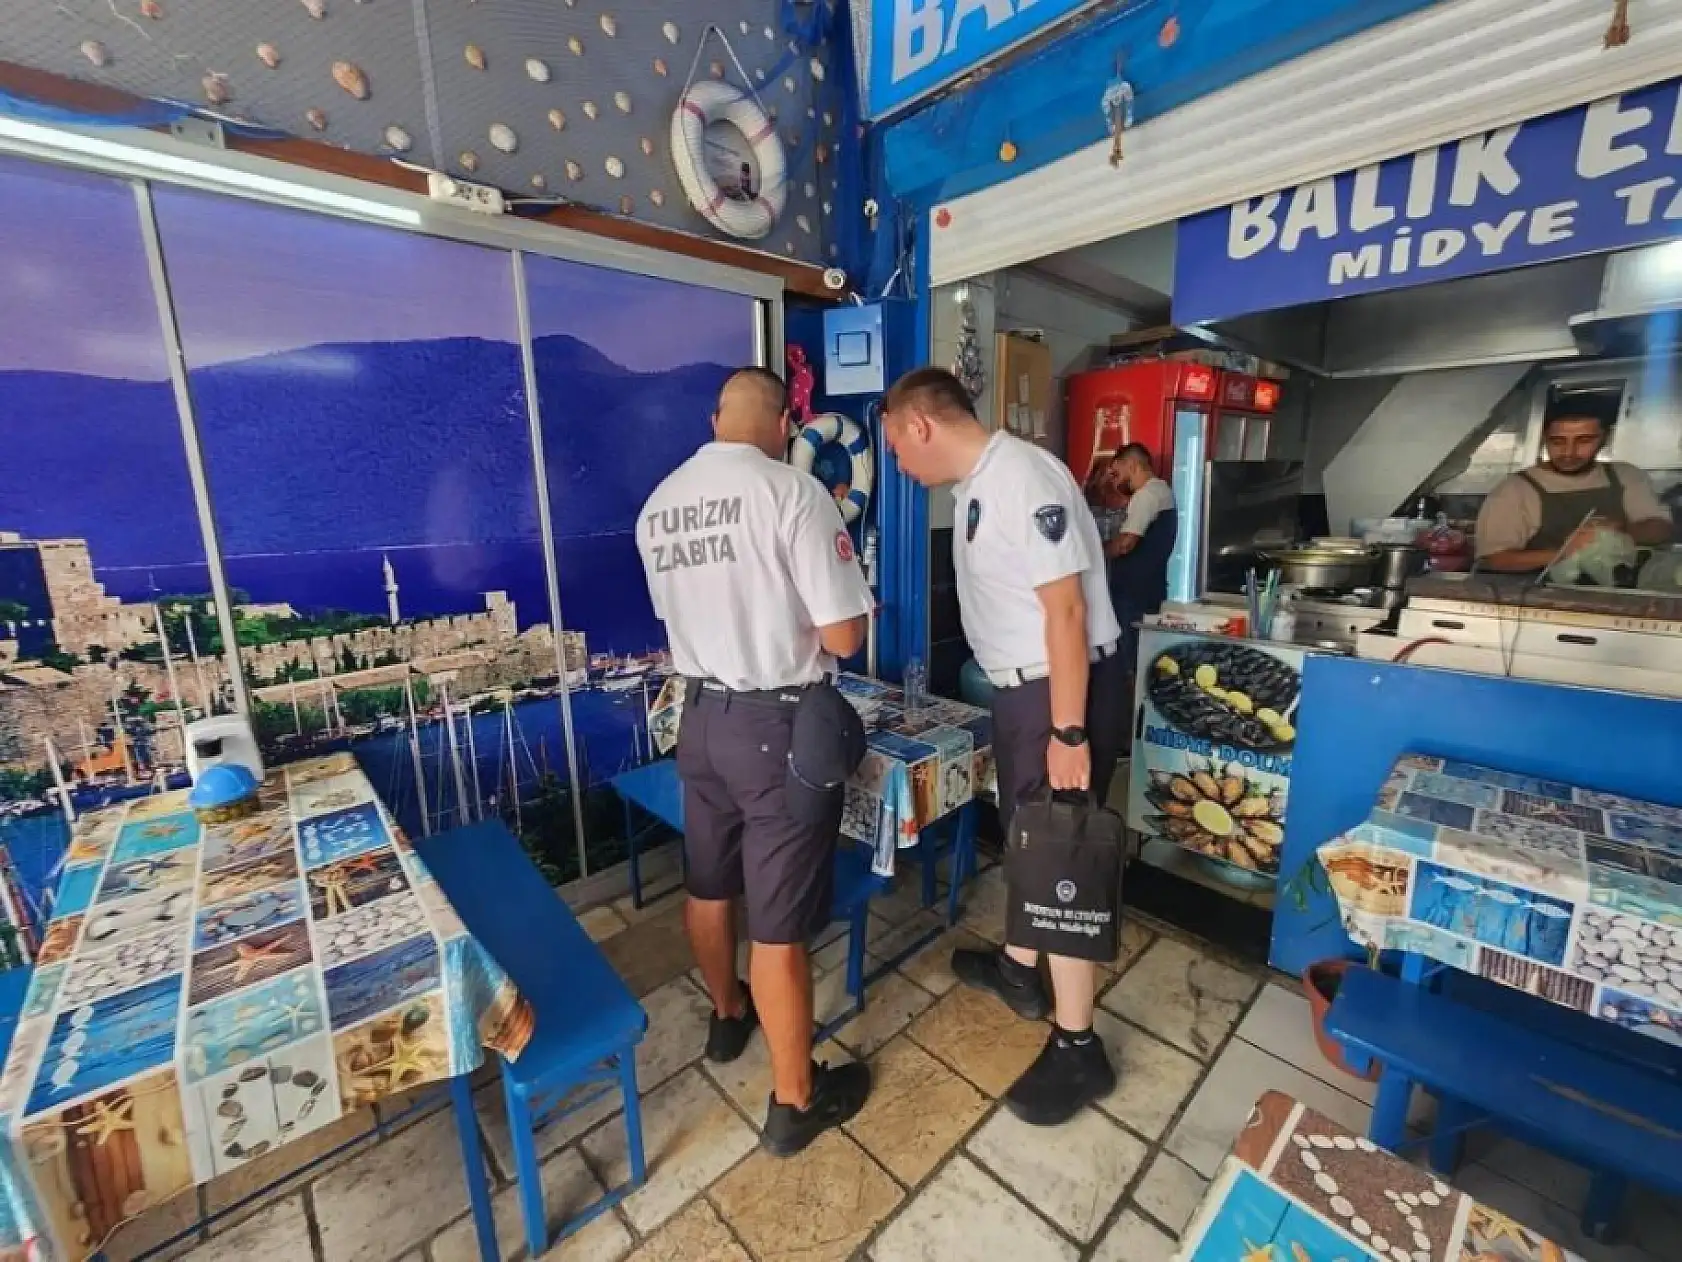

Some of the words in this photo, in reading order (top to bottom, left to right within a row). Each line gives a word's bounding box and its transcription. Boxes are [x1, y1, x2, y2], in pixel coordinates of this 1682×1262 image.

[1228, 125, 1522, 260] BALIK
[1329, 201, 1579, 285] MİDYE
[647, 496, 742, 539] TURİZM
[651, 534, 737, 573] ZABITA
